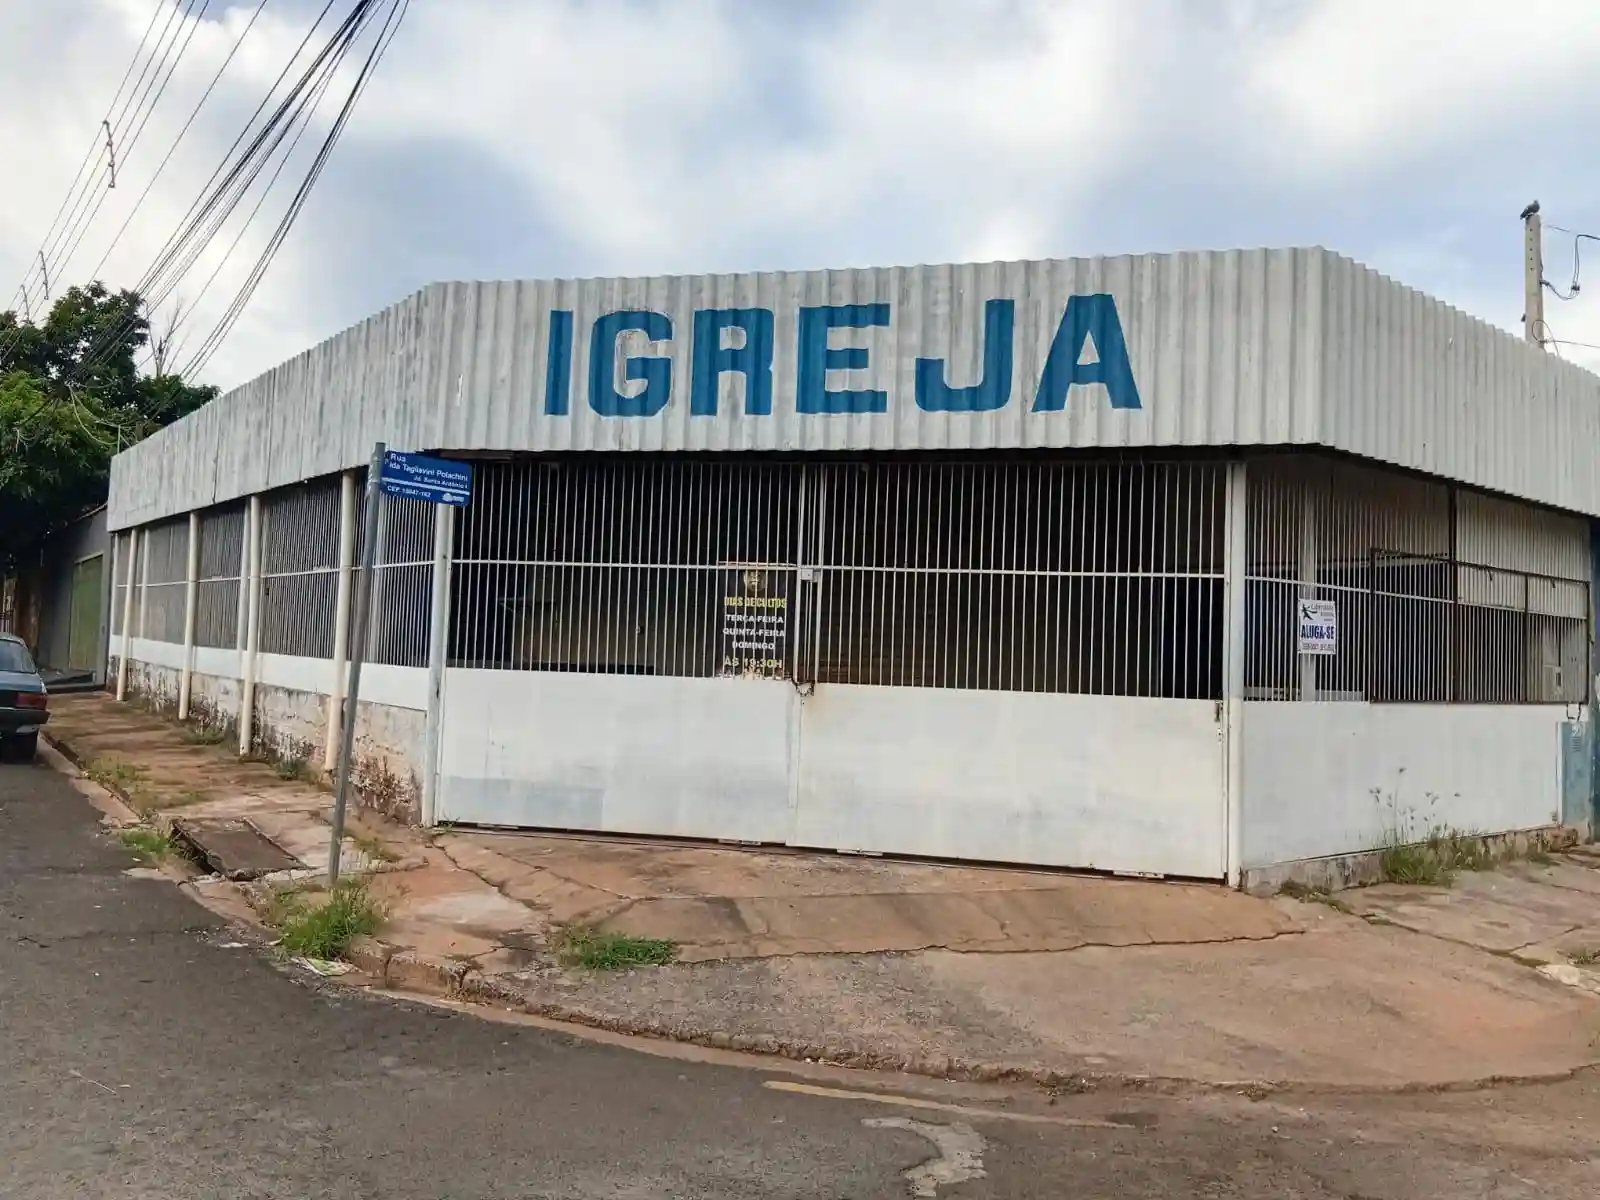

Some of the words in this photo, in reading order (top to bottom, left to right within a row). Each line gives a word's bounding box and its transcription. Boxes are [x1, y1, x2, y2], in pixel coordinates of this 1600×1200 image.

[544, 292, 1143, 417] IGREJA
[390, 453, 406, 462] Rua
[389, 462, 401, 470] Ida
[724, 596, 743, 607] DIAS
[755, 597, 787, 609] CULTOS
[723, 627, 785, 637] QUINTA-FEIRA
[1301, 624, 1334, 639] ALUGA-SE
[732, 641, 775, 650] DOMINGO
